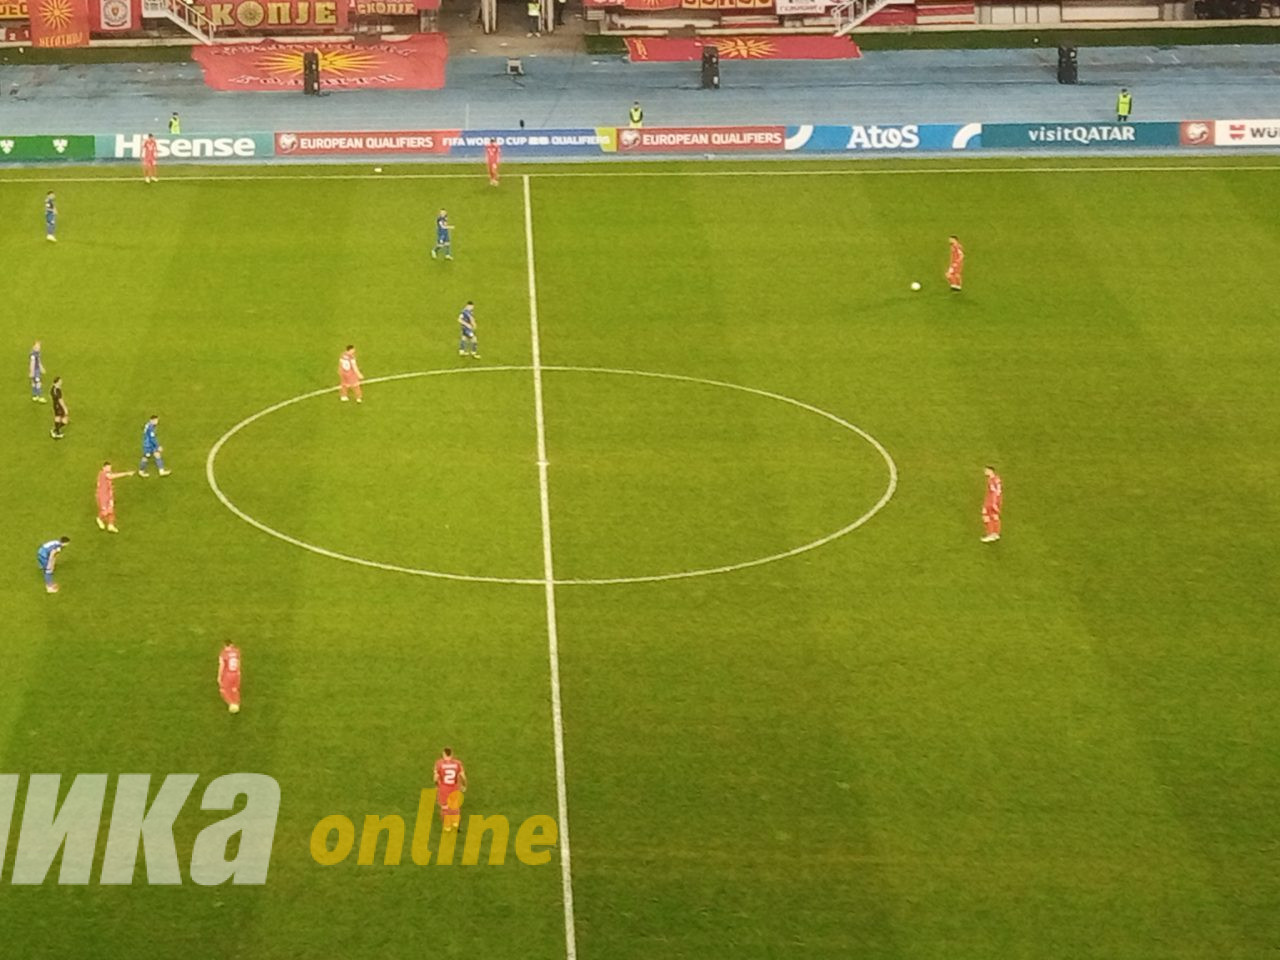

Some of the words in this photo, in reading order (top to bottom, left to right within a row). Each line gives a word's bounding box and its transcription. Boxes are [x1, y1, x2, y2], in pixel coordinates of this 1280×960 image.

[643, 134, 708, 146] EUROPEAN
[712, 132, 782, 145] QUALIFIERS
[1028, 126, 1136, 143] visitQATAR
[1250, 127, 1280, 138] WÜ
[300, 136, 362, 149] EUROPEAN
[366, 136, 434, 149] QUALIFIERS
[443, 769, 456, 785] 2
